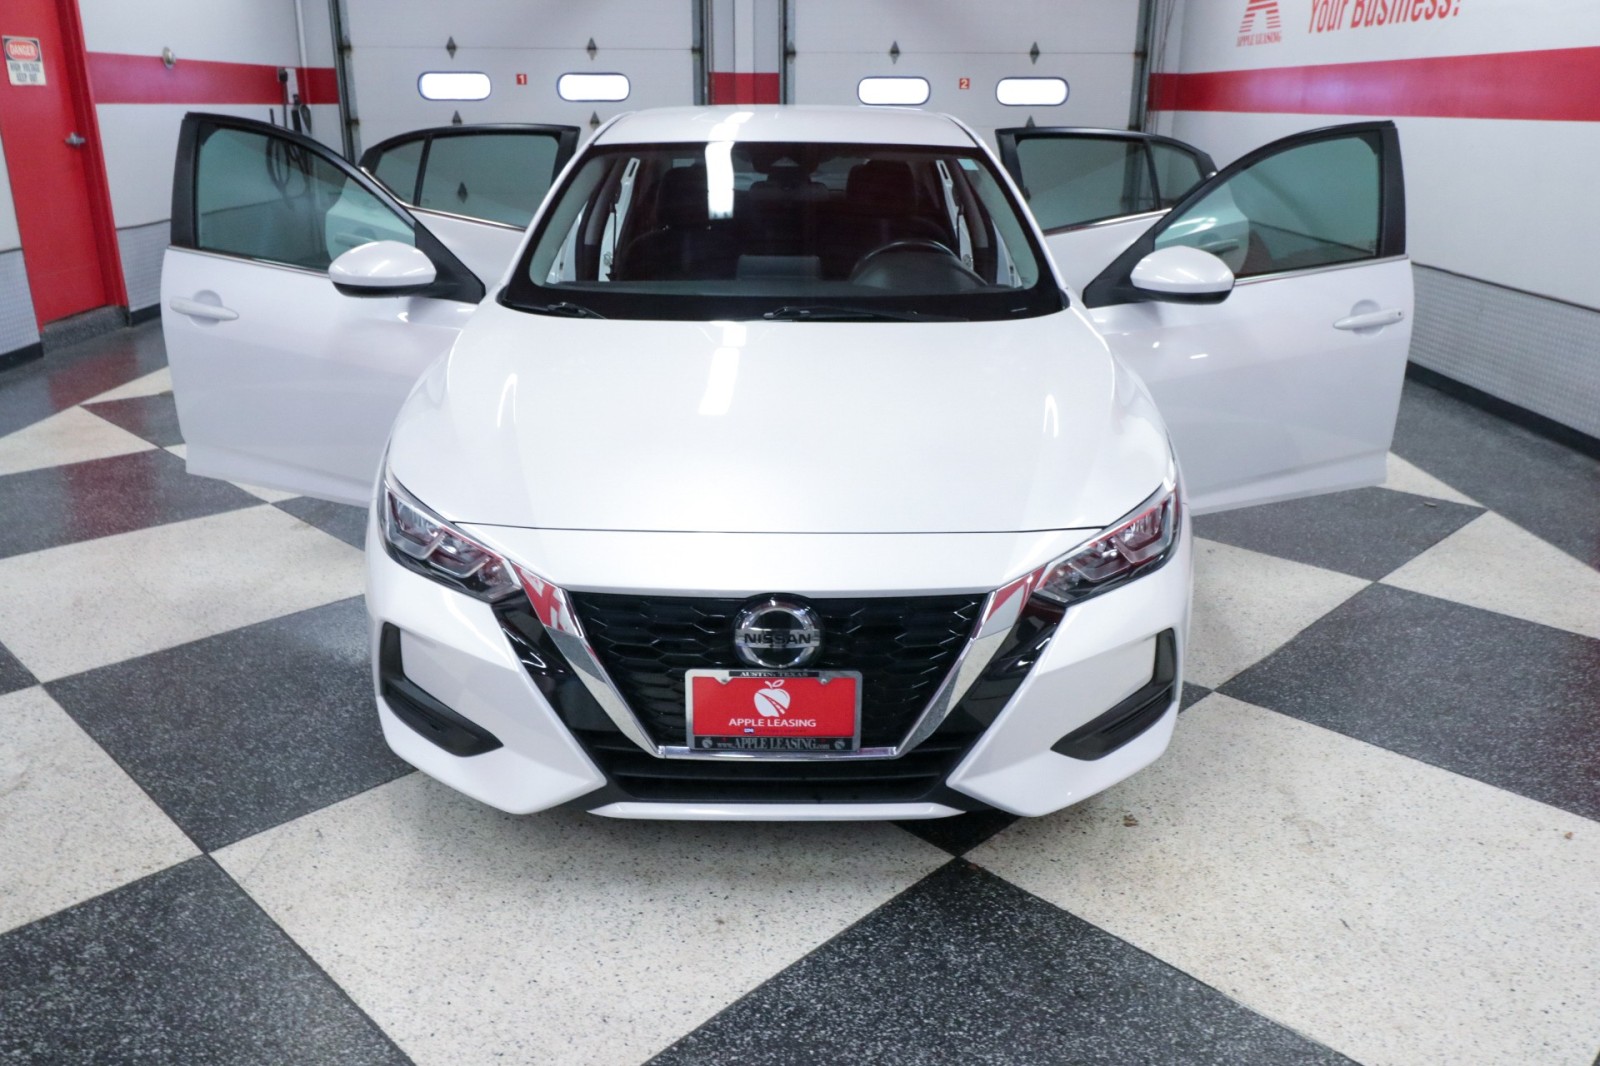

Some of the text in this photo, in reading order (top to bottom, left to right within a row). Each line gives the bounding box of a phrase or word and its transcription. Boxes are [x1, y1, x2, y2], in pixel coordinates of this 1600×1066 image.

[1308, 0, 1349, 33] Your
[9, 43, 36, 56] DANGER
[960, 79, 969, 89] 2
[744, 633, 811, 644] NISSAN
[728, 718, 817, 727] APPLE LEASING
